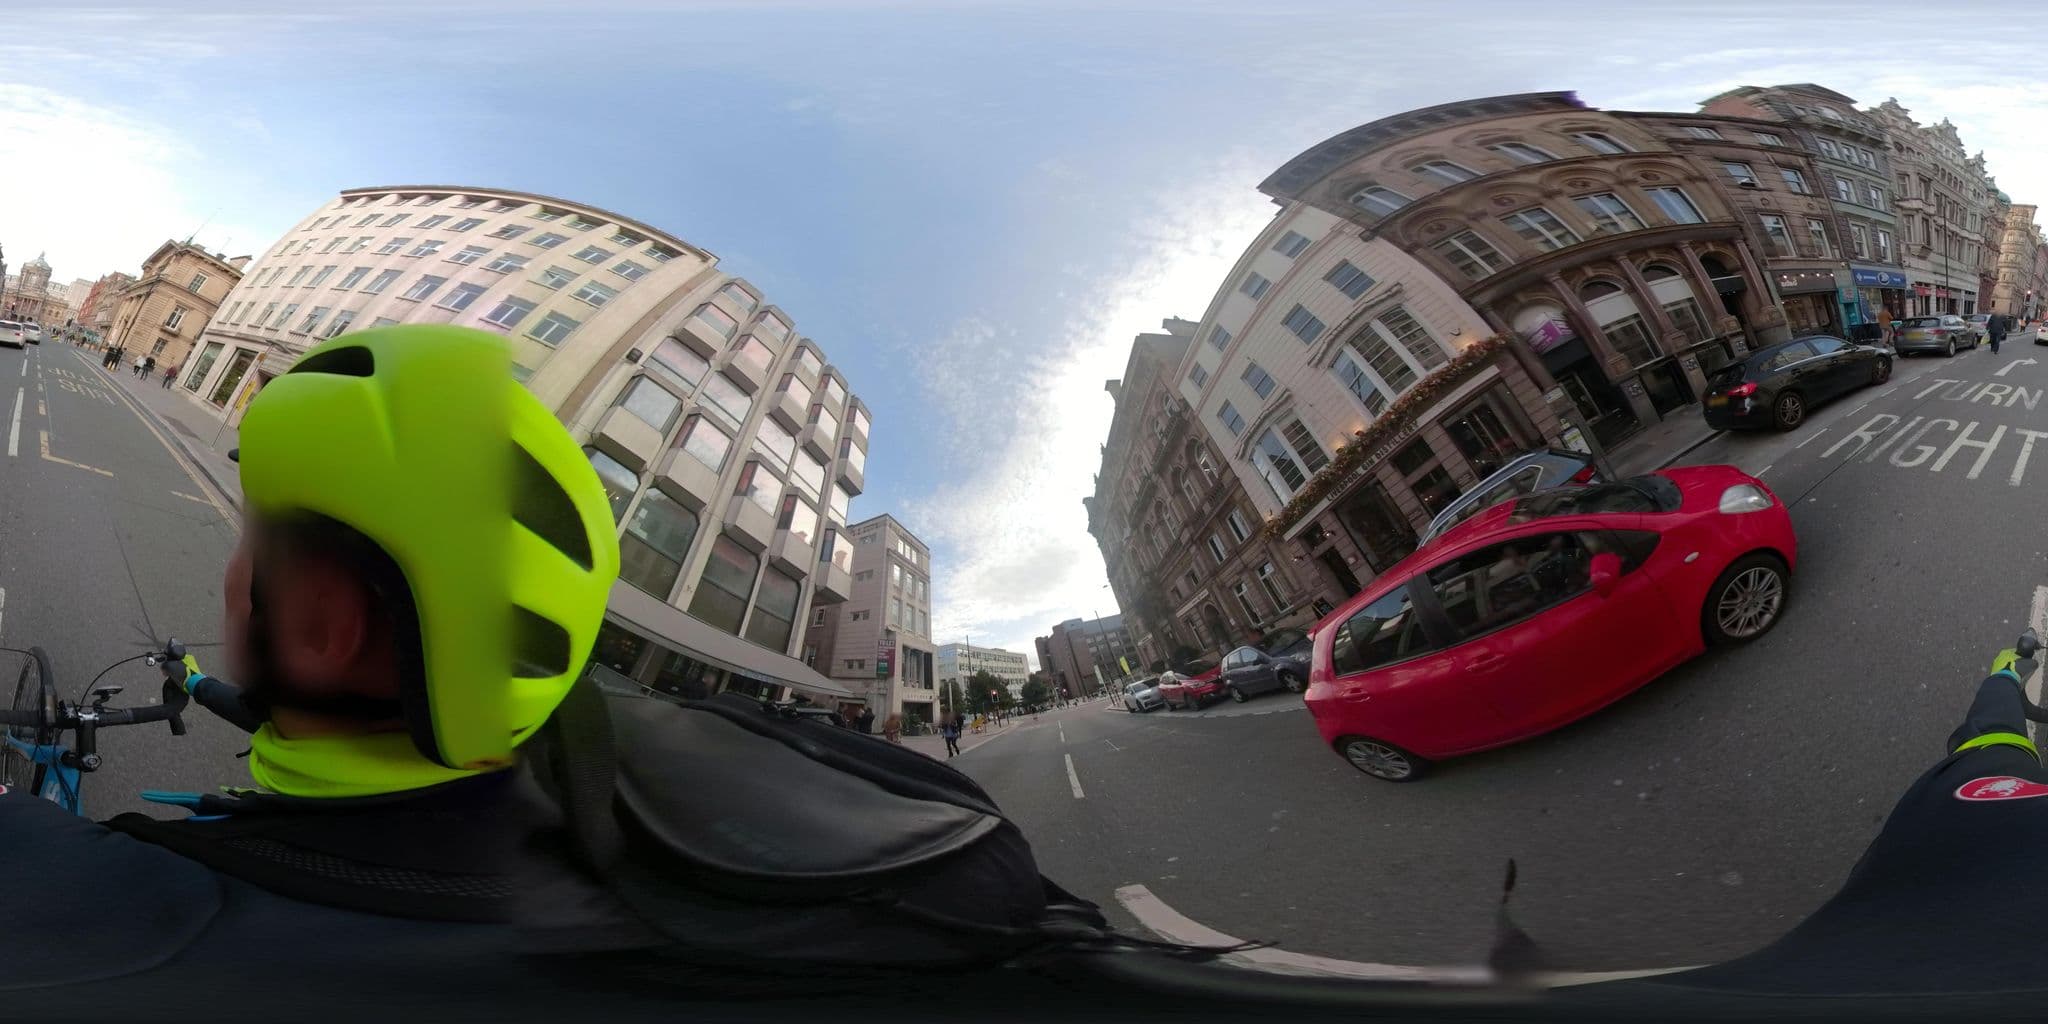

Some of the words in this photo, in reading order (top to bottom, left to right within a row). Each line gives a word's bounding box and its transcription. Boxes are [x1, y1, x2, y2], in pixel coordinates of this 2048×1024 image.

[1914, 378, 2044, 410] TURN
[1326, 471, 1362, 501] LIVERPOOL
[1361, 459, 1375, 471] GIN
[1375, 420, 1418, 460] DISTILLERY
[1820, 413, 2048, 487] RIGHT
